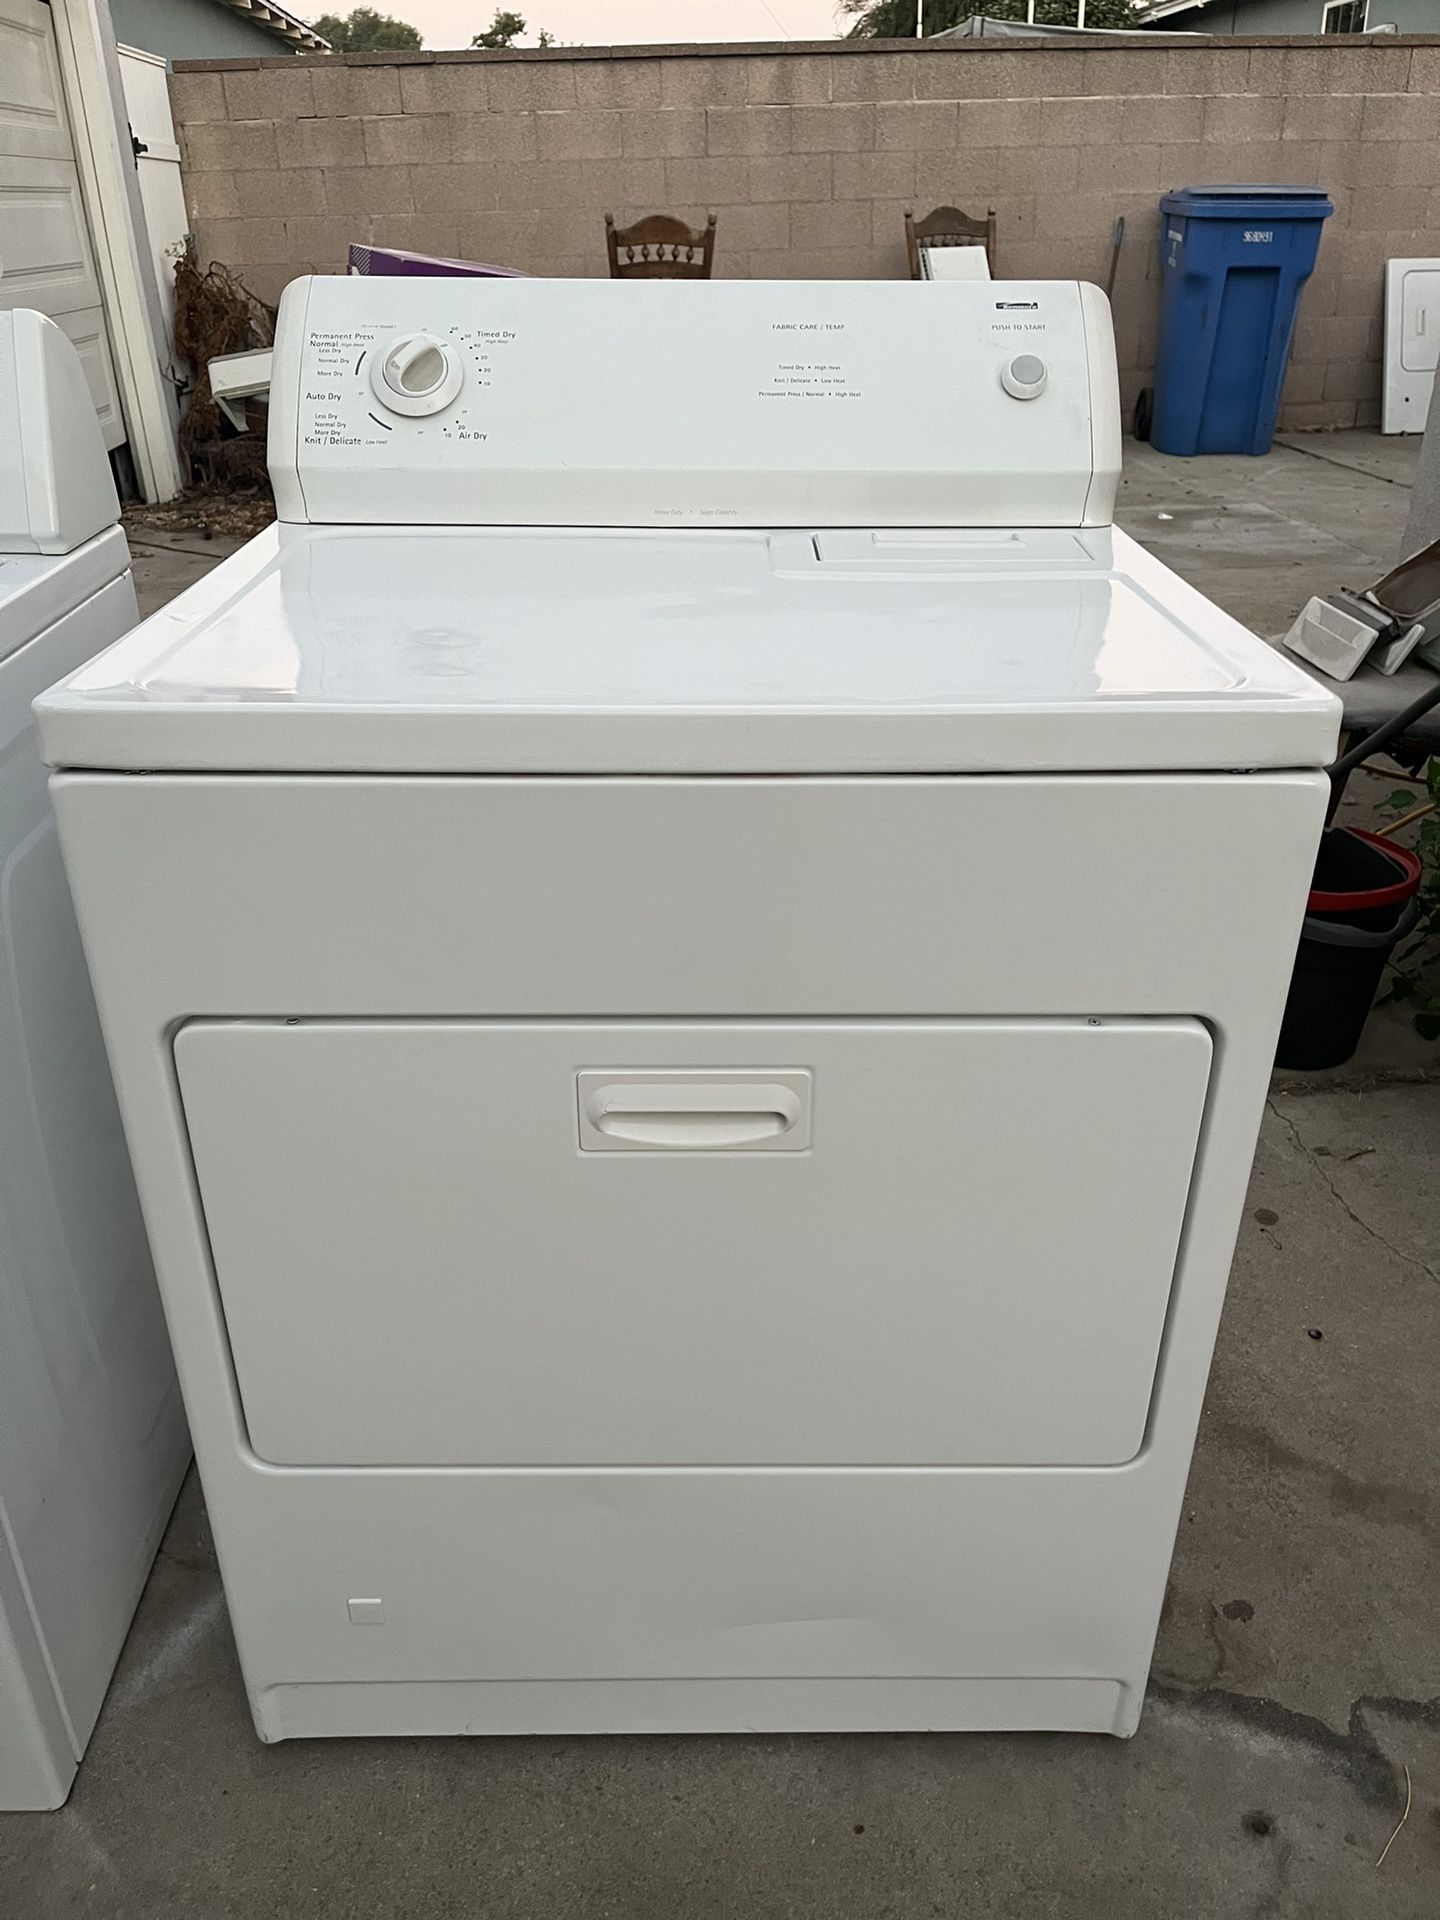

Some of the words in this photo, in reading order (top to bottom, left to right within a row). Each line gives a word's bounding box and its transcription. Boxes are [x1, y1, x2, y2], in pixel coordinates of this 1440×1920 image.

[310, 332, 352, 340] Permanent
[502, 331, 517, 339] Dry
[328, 393, 342, 401] Dry
[473, 432, 487, 441] Dry
[304, 437, 321, 445] Knit
[329, 437, 362, 445] Delicate
